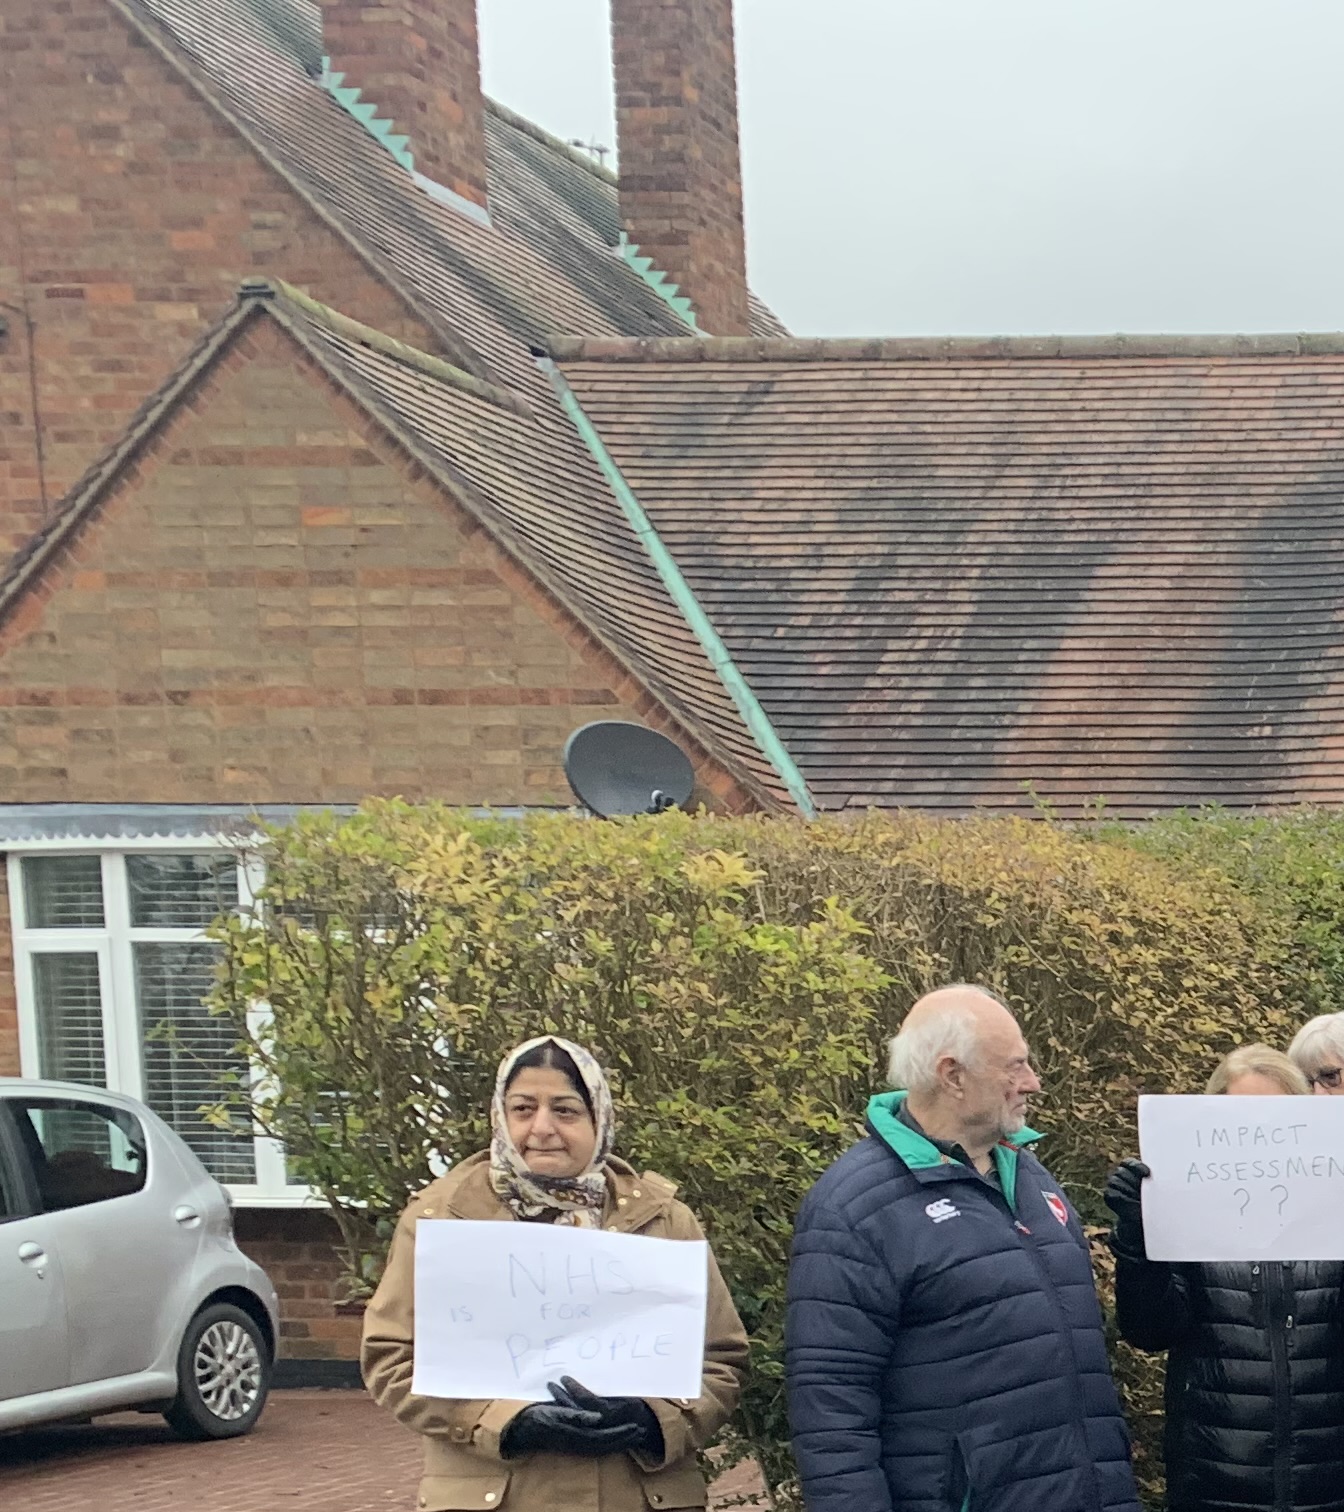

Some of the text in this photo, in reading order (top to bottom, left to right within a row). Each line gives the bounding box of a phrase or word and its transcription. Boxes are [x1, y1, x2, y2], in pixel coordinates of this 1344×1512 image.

[1196, 1123, 1308, 1148] IMPACT
[508, 1251, 635, 1299] NHS
[450, 1302, 593, 1323] IS FOR
[504, 1331, 674, 1380] PEOPLE
